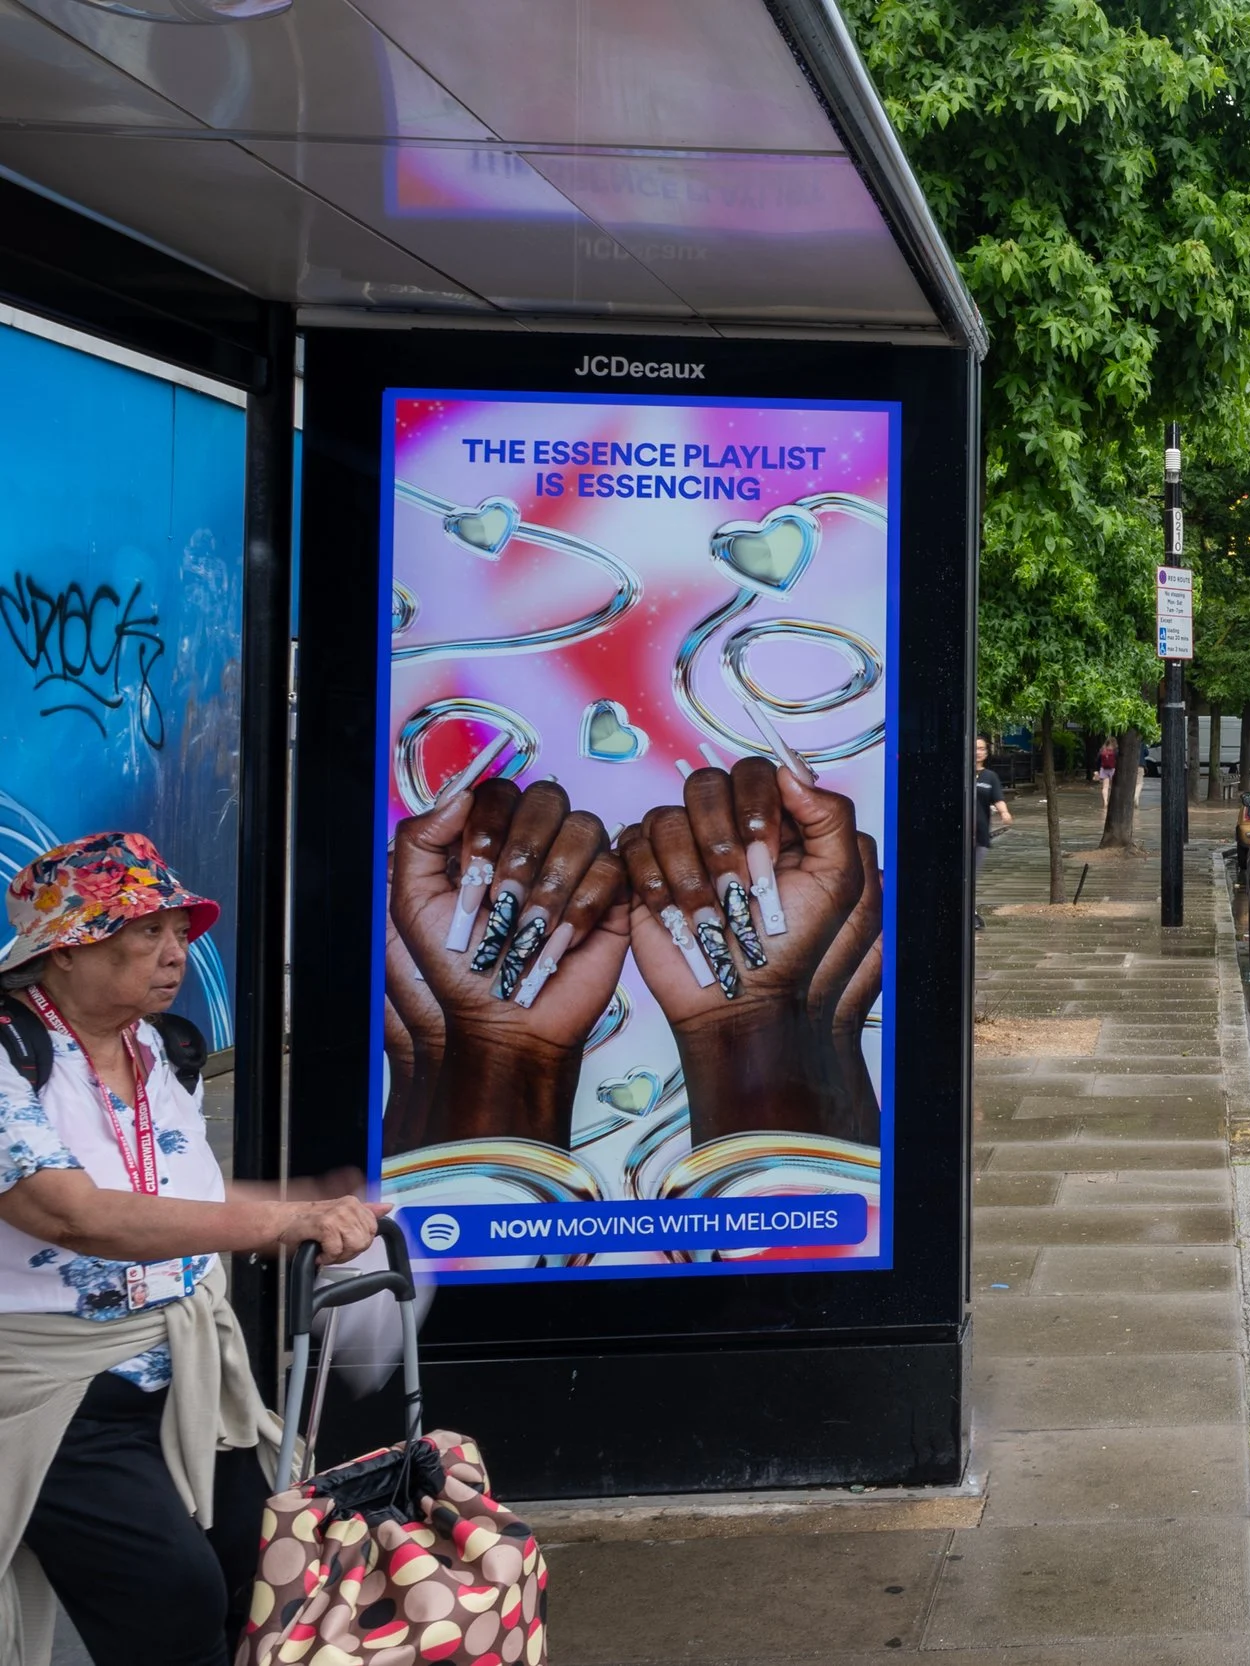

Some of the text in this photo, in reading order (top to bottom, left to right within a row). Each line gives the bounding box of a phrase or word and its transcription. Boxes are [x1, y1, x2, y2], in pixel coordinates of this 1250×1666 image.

[574, 355, 706, 379] JCDecaux
[462, 438, 826, 471] THE ESSENCE PLAYLIST
[535, 472, 761, 500] IS ESSENCING
[1174, 510, 1183, 552] 0210
[139, 1100, 150, 1132] DESIGN
[140, 1132, 157, 1193] CLERKENWELL
[489, 1209, 839, 1240] NOW MOVING WITH MELODIES
